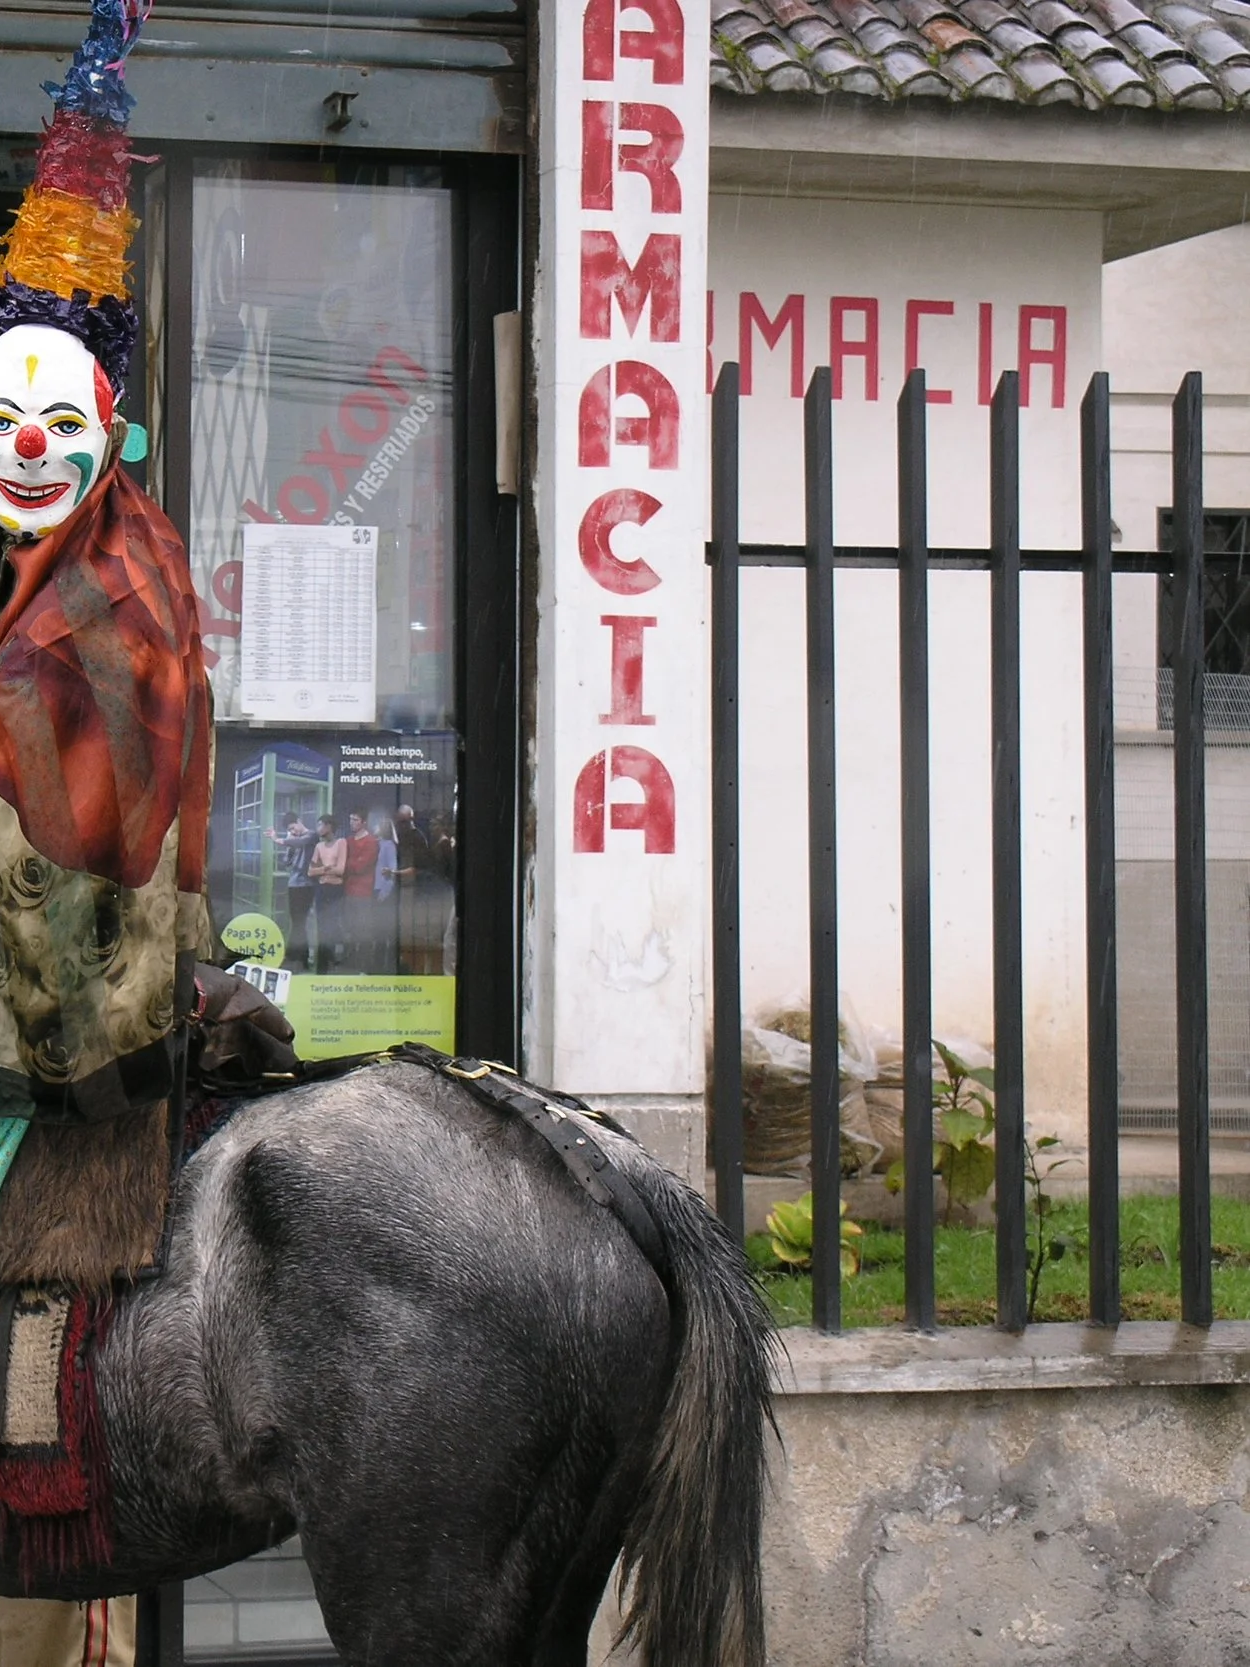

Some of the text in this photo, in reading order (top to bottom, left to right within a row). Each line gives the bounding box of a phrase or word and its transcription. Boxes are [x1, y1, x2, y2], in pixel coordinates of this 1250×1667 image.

[354, 394, 437, 500] RESFRIADOS
[340, 745, 424, 758] Tómate tu tiempo,
[340, 760, 438, 771] porque ahora tendrás
[340, 773, 415, 785] más para hablar.
[226, 928, 267, 941] Paga $3
[311, 984, 342, 994] Tarjetas
[344, 984, 353, 993] de
[393, 984, 423, 993] Pública
